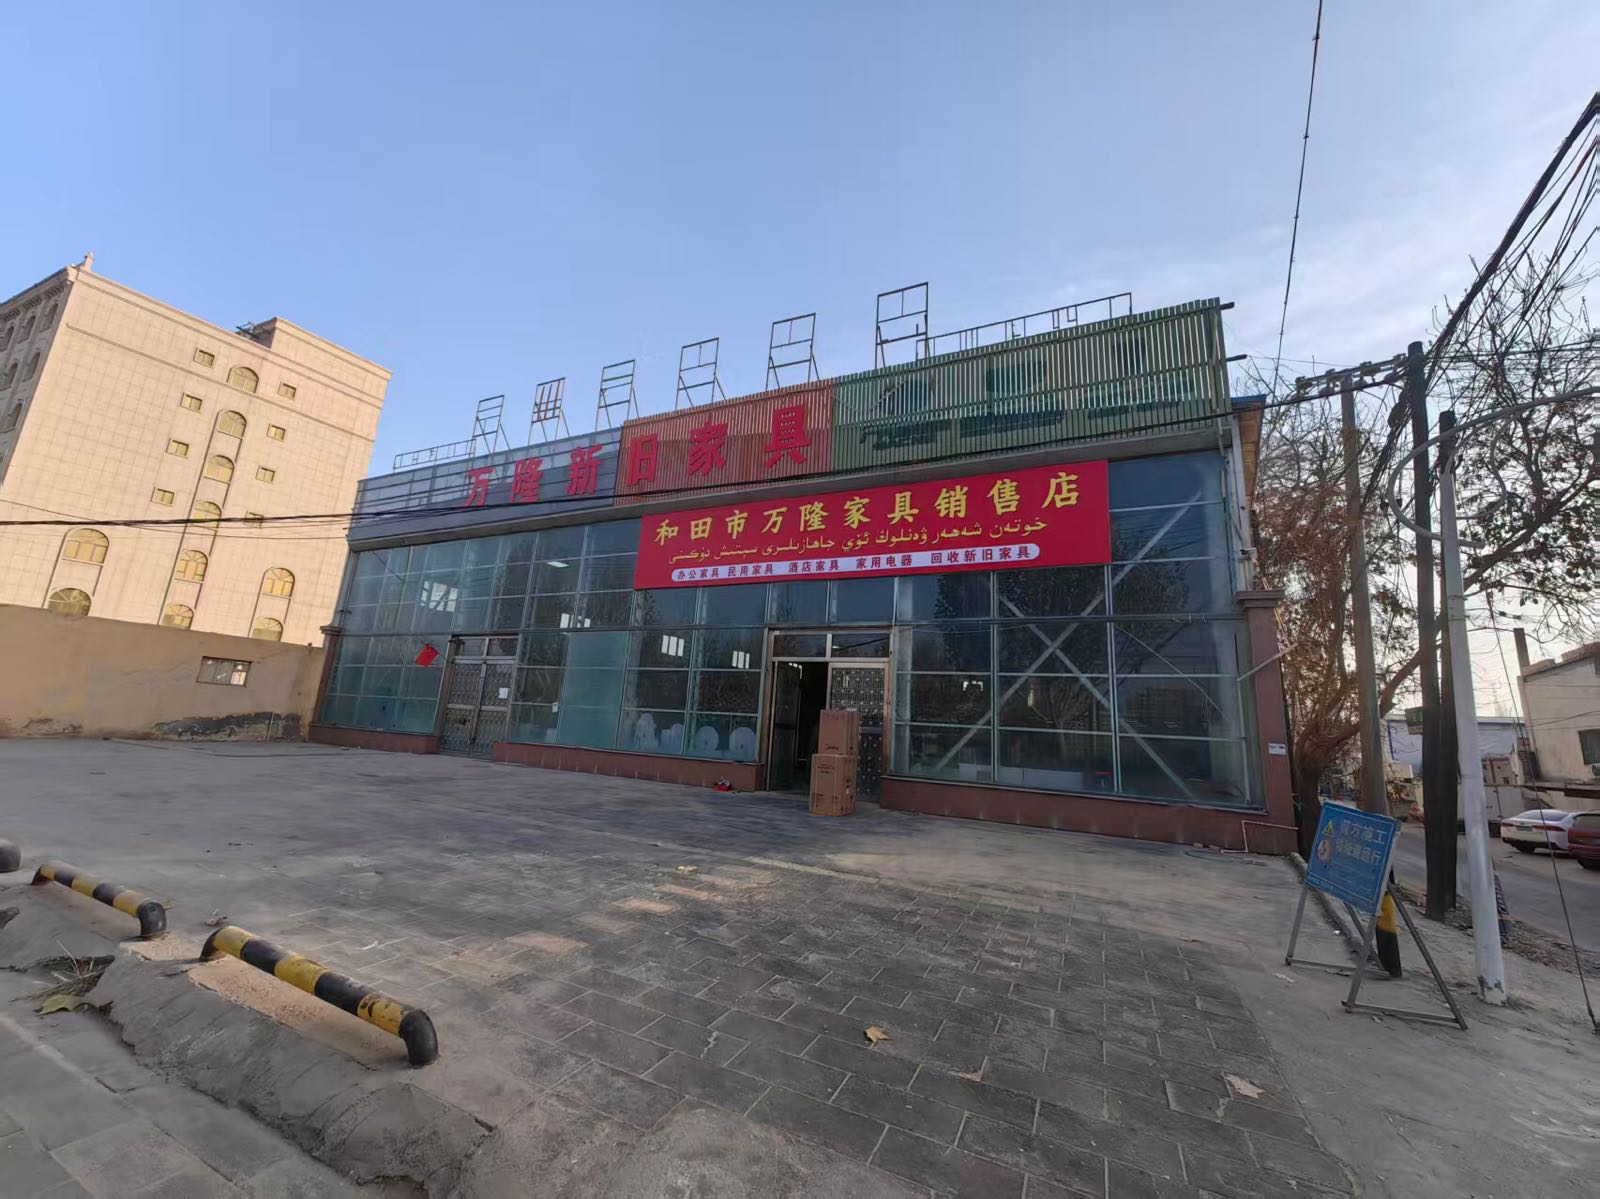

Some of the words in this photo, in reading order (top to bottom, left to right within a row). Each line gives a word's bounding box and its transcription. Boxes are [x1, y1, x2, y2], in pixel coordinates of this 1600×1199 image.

[654, 471, 1079, 546] 和田市万隆家具销售店
[677, 567, 720, 580] 办公家具
[727, 563, 774, 577] 民用家具
[788, 560, 840, 574] 酒店家具
[856, 554, 913, 569] 家用电器
[931, 545, 1030, 564] 回收新旧家具
